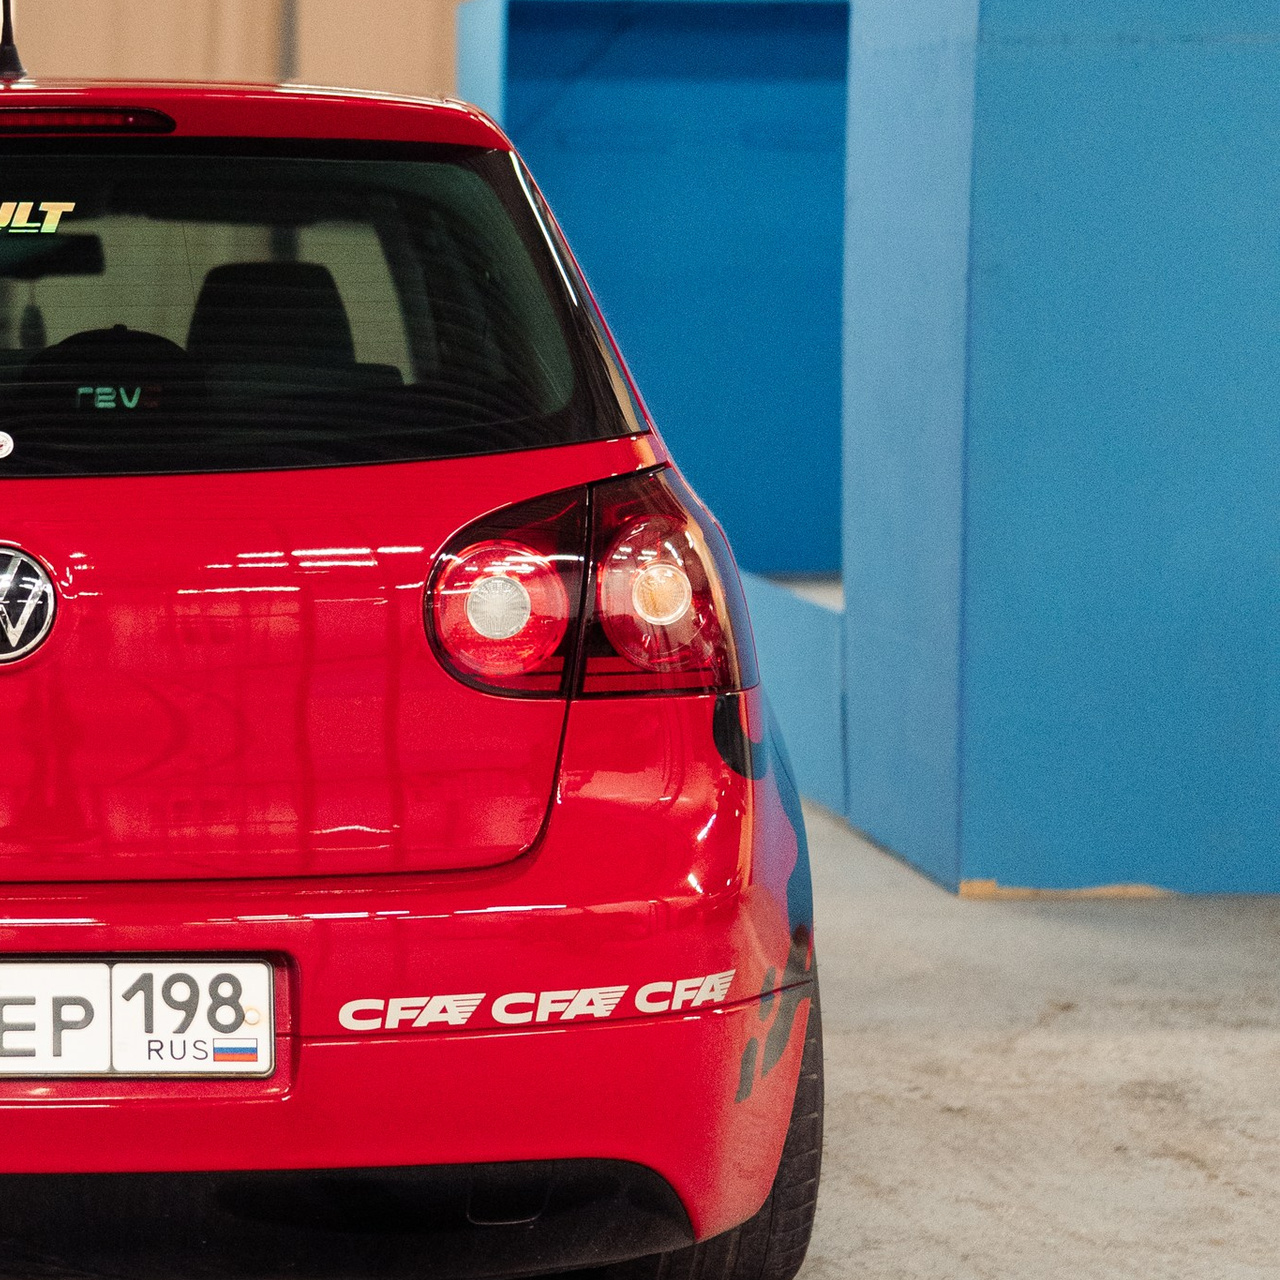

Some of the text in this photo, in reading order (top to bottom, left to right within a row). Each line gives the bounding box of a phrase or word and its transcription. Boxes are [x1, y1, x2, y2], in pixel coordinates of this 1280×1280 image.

[121, 972, 247, 1034] 198
[338, 970, 737, 1031] CFA CFA CFA
[147, 1039, 209, 1061] RUS
